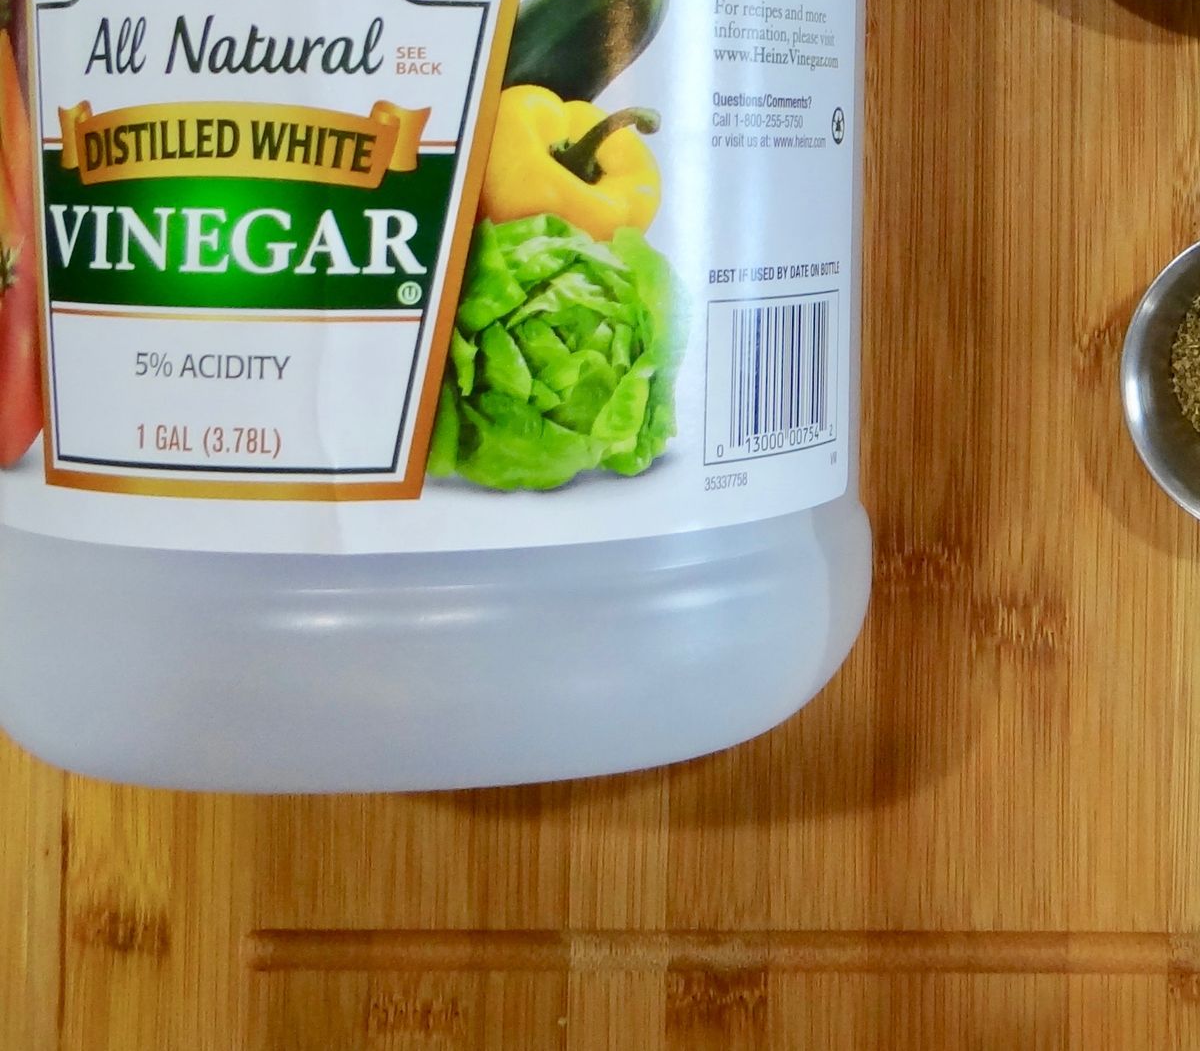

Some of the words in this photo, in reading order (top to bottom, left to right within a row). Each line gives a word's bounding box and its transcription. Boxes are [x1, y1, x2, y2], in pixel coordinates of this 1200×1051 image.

[743, 0, 783, 23] recipes
[784, 4, 803, 21] and
[805, 10, 827, 24] more
[84, 15, 147, 76] All
[164, 14, 386, 76] Natural
[713, 21, 791, 44] information,
[792, 27, 820, 48] please
[820, 29, 836, 47] visit
[395, 45, 428, 61] SEE
[713, 45, 840, 72] www.HeinzVinegar.com
[395, 60, 443, 76] BACK
[712, 90, 813, 110] Questions/Comments?
[712, 111, 731, 128] Call
[734, 113, 804, 130] 1-800-255-5750
[84, 118, 241, 172] DISTILLED
[250, 120, 377, 174] WHITE
[711, 135, 723, 149] or
[724, 134, 745, 149] visit
[746, 136, 758, 149] us
[760, 135, 771, 149] at:
[773, 135, 827, 150] www.heinz.com
[48, 204, 428, 276] VINEGAR
[708, 268, 736, 284] BEST
[738, 268, 748, 283] IF
[750, 266, 775, 282] USED
[776, 266, 788, 281] BY
[790, 264, 809, 279] DATE
[810, 263, 820, 278] ON
[820, 261, 840, 277] BOTTLE
[134, 351, 173, 378] 5%
[180, 353, 291, 381] ACIDITY
[136, 424, 145, 449] 1
[155, 424, 193, 452] GAL
[203, 427, 282, 459] (3.78L)
[716, 443, 725, 459] 0
[746, 431, 785, 455] 13000
[789, 424, 819, 447] 00754
[704, 471, 748, 492] 35337758
